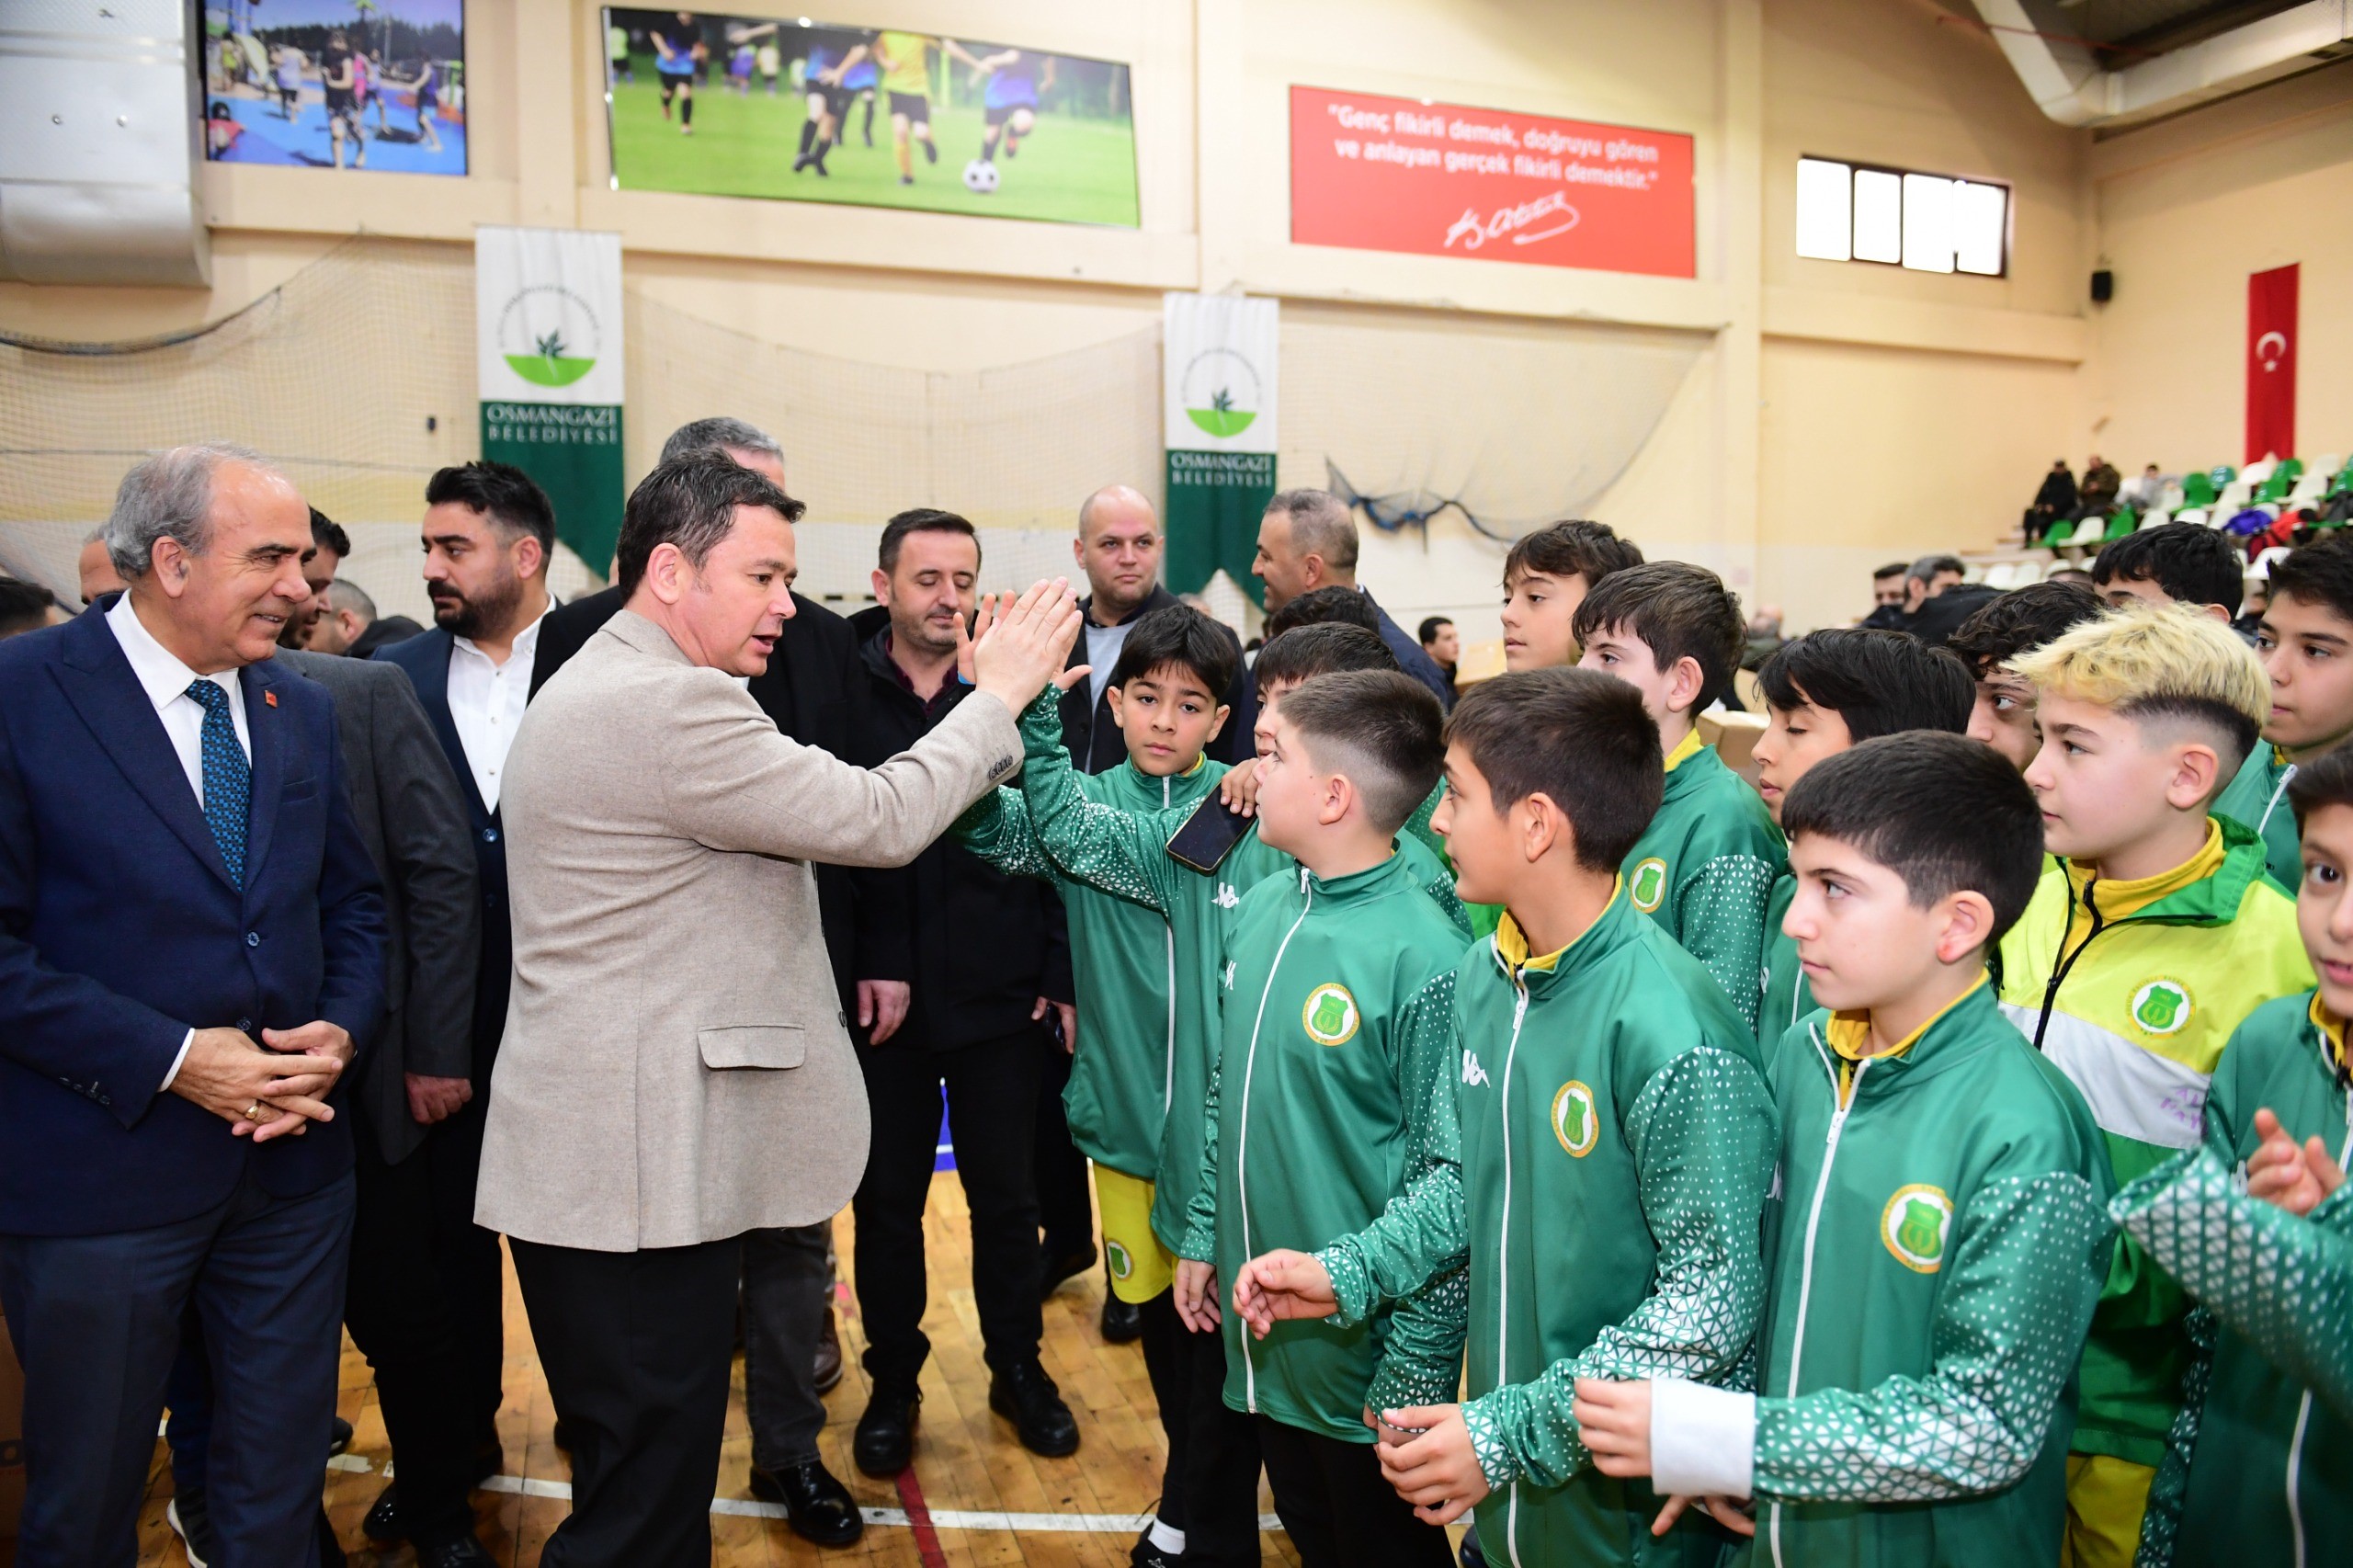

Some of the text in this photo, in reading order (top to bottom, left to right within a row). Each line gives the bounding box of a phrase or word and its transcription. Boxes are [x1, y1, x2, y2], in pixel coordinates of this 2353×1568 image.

[1334, 138, 1360, 159] ve
[1363, 140, 1441, 169] anlayan
[1445, 150, 1511, 176] gerçek
[1513, 154, 1562, 181] fikirli
[1393, 110, 1446, 138] fikirli
[1449, 119, 1521, 150] demek,
[1523, 127, 1602, 159] doğruyu
[1605, 139, 1659, 164] gören
